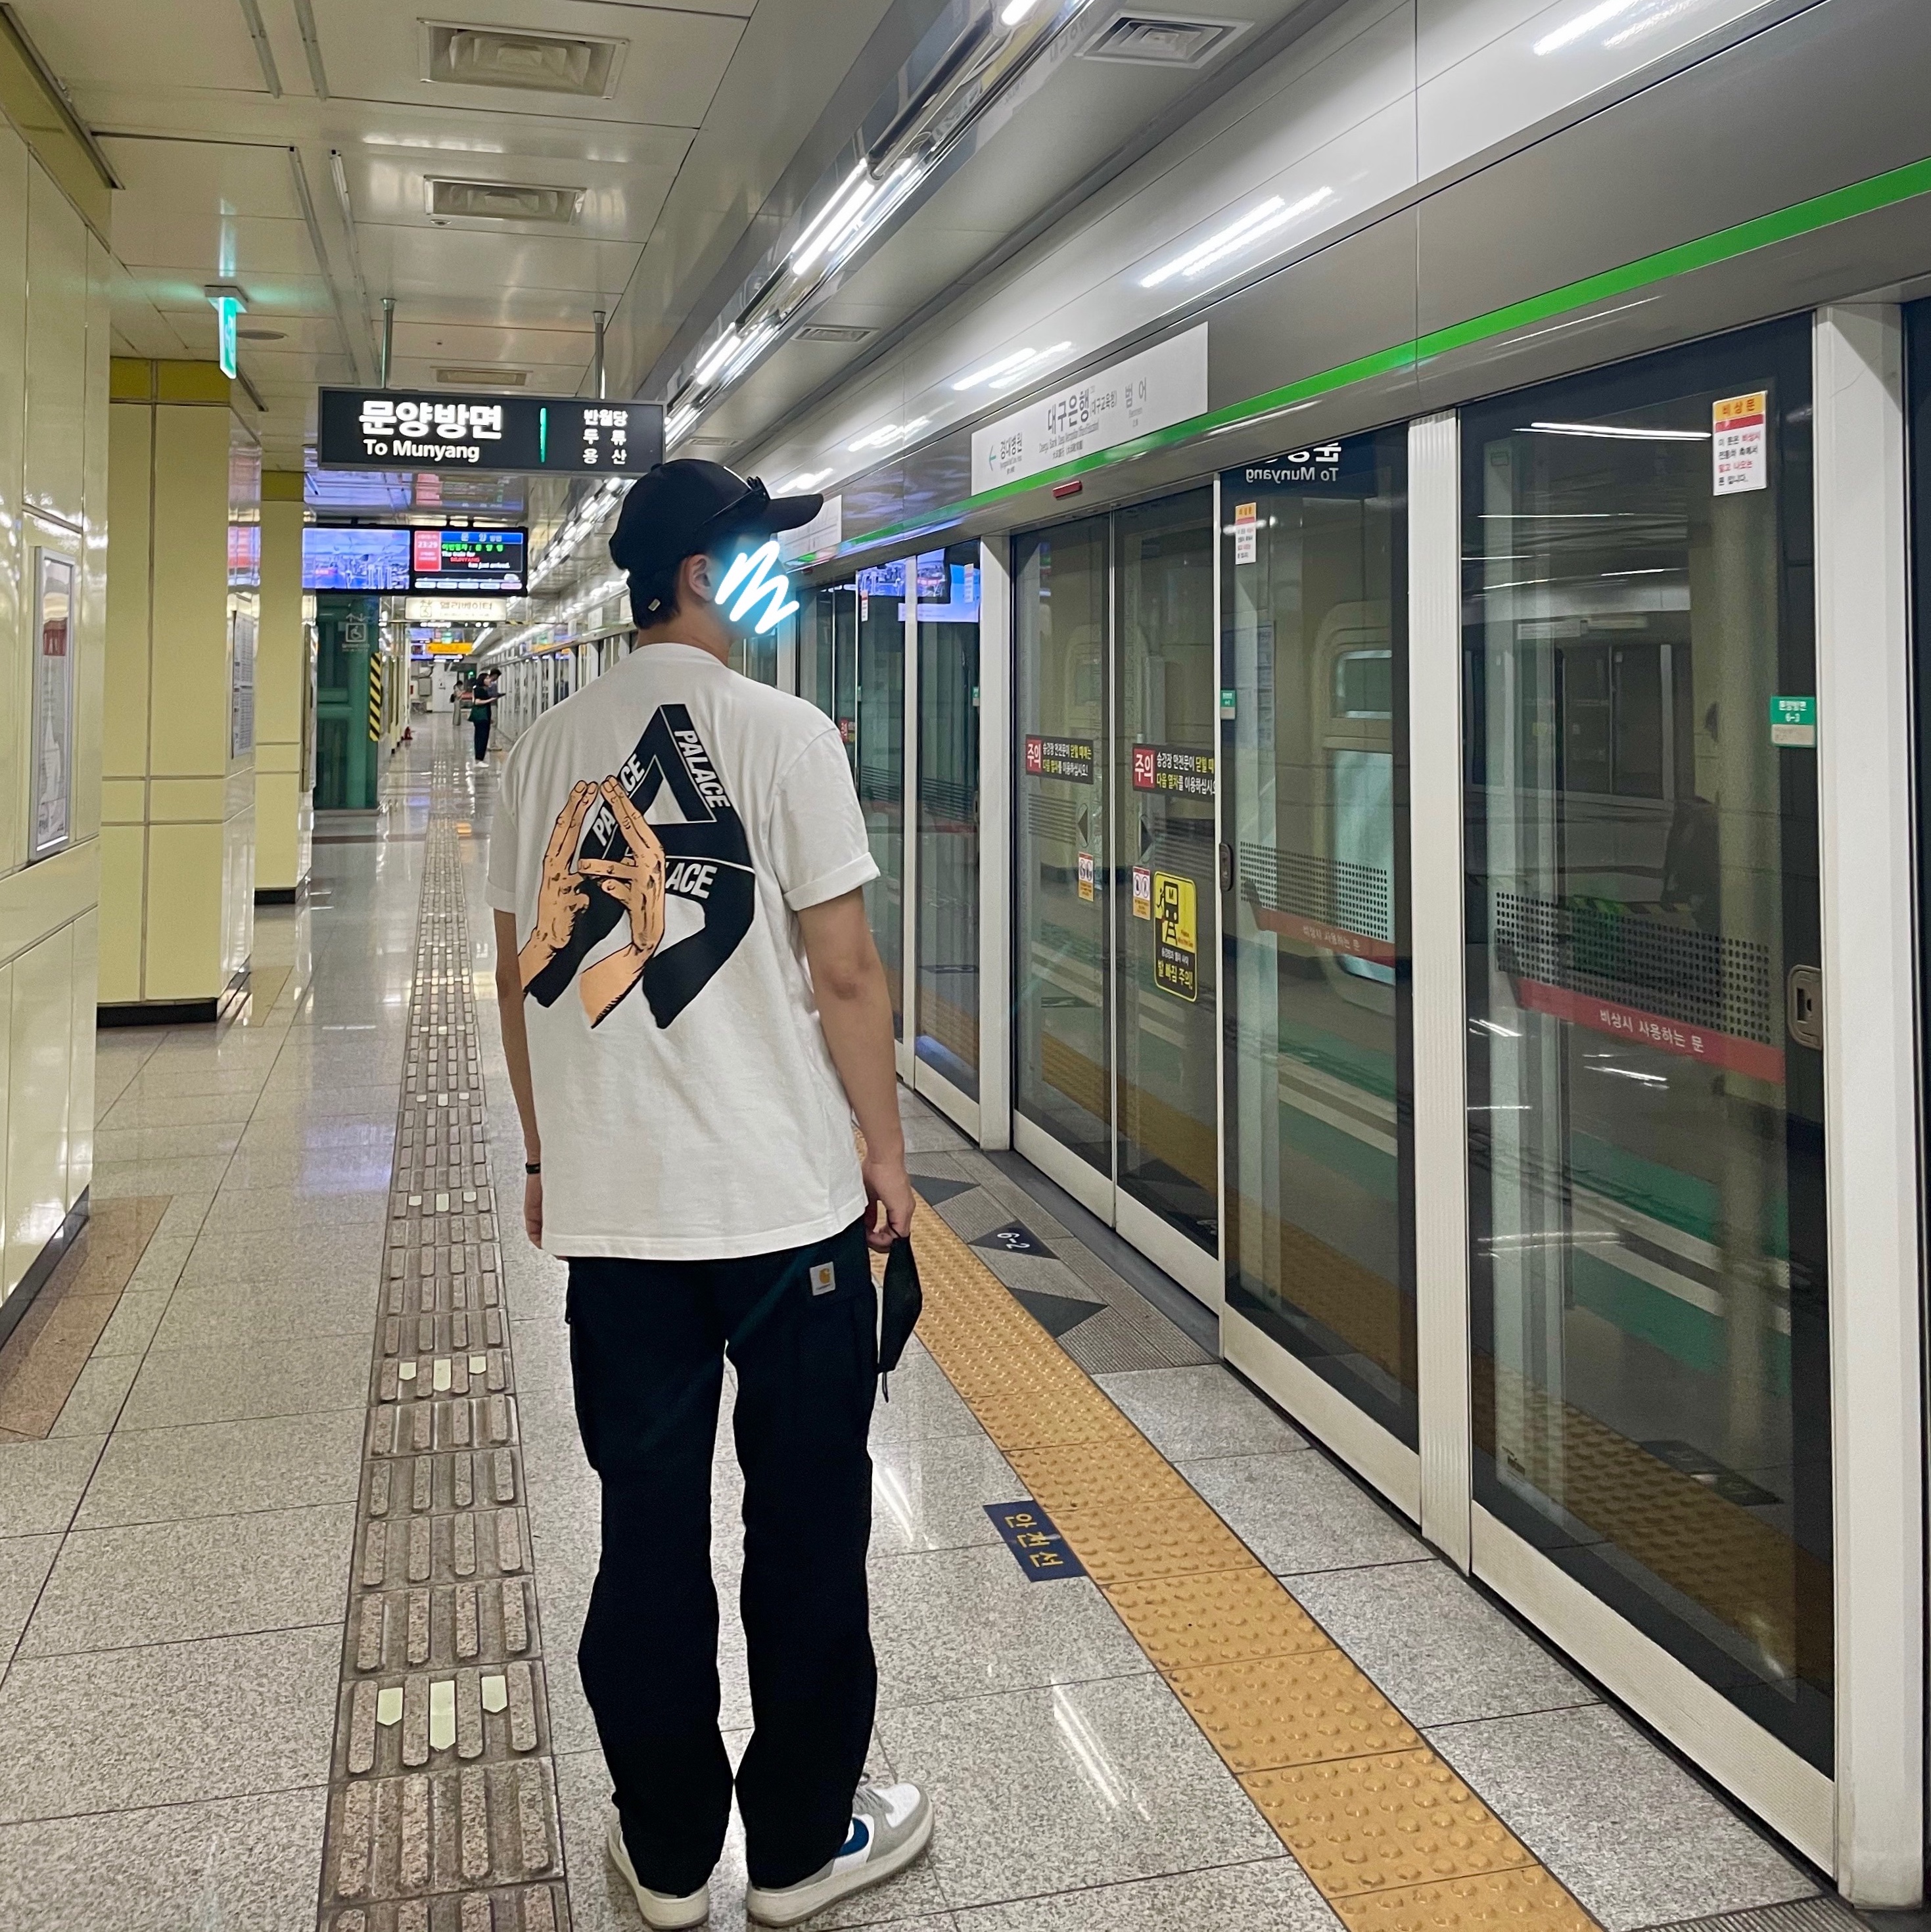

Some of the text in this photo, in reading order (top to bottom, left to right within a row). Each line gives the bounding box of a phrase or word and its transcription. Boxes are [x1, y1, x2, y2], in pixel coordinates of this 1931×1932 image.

[359, 400, 501, 440] 문양방면
[583, 409, 628, 427] 반월당
[1048, 387, 1089, 434] 대구은행
[363, 439, 480, 463] To Munyang
[440, 601, 493, 610] 엘리베이터
[1027, 743, 1041, 769] 주의
[1043, 743, 1054, 756] 승강장
[1157, 752, 1173, 769] 승강장
[1173, 754, 1195, 771] 안전문이
[1196, 756, 1207, 773] 닫힐
[674, 730, 731, 808] PALACE
[1043, 759, 1050, 773] 다음
[1134, 754, 1153, 783] 주의
[1157, 773, 1167, 788] 다음
[1168, 774, 1184, 791] 열차를
[592, 753, 645, 847] PACE
[665, 862, 718, 899] ACE
[1600, 1009, 1704, 1053] 비상시 사용하는 문
[997, 1231, 1031, 1249] 6-2
[1004, 1513, 1063, 1567] 안전선
